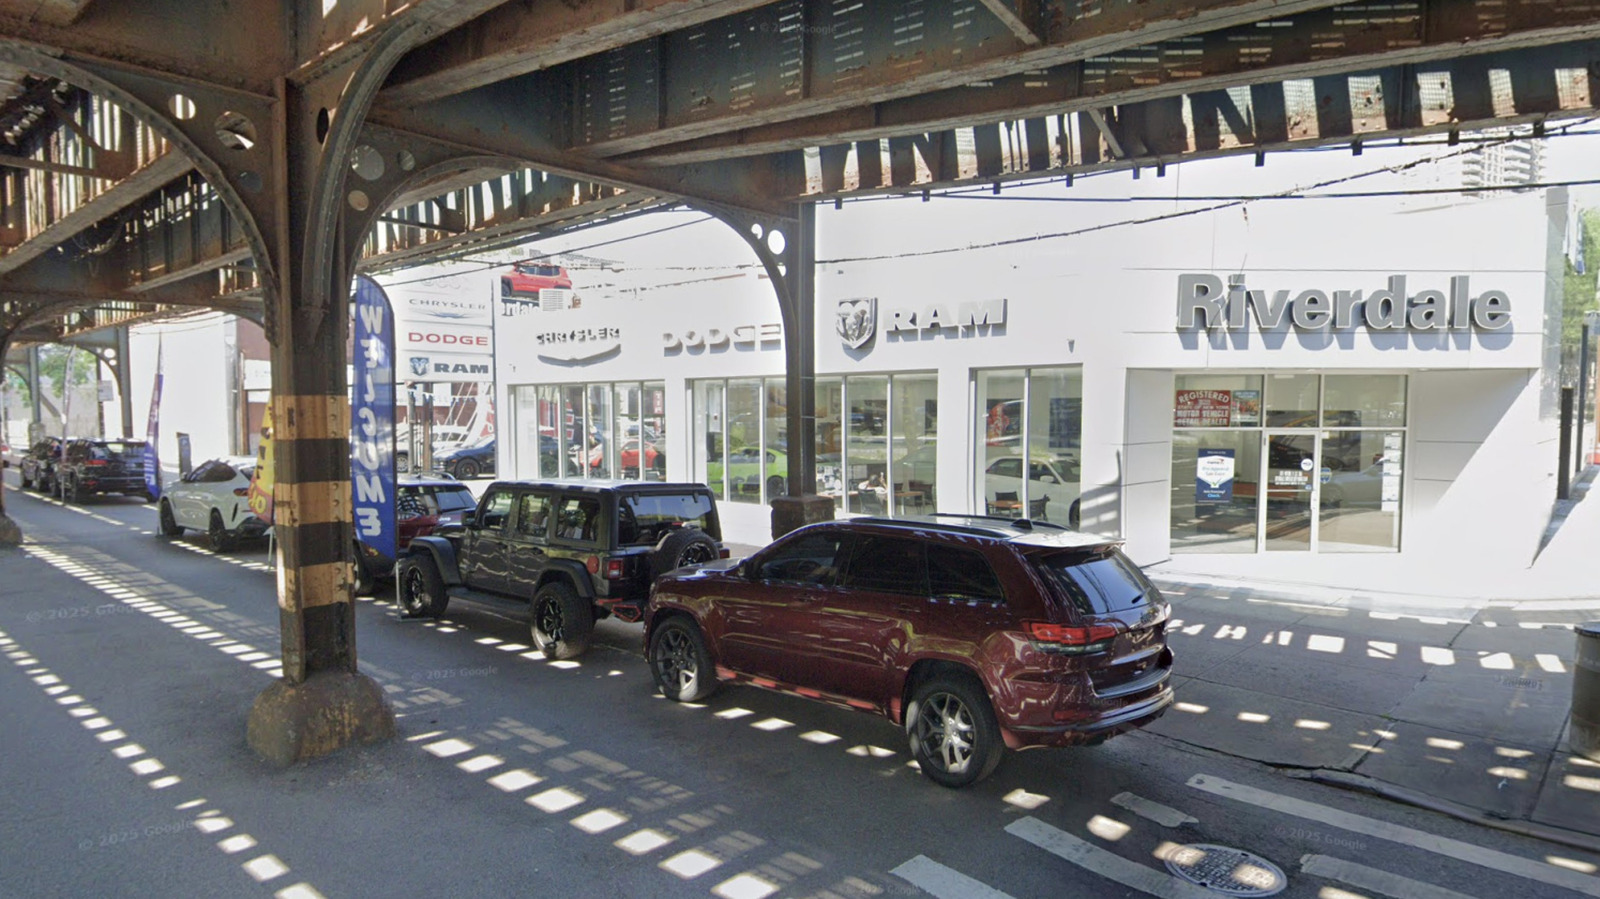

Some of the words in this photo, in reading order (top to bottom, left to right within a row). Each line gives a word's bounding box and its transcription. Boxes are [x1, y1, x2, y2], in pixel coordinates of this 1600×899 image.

[408, 298, 486, 310] CHRYSLER
[1177, 273, 1512, 331] Riverdale
[884, 299, 1007, 337] RAM
[408, 332, 489, 346] DODGE
[663, 324, 782, 353] DODGE
[434, 362, 489, 374] RAM
[1178, 390, 1230, 404] REGISTERED
